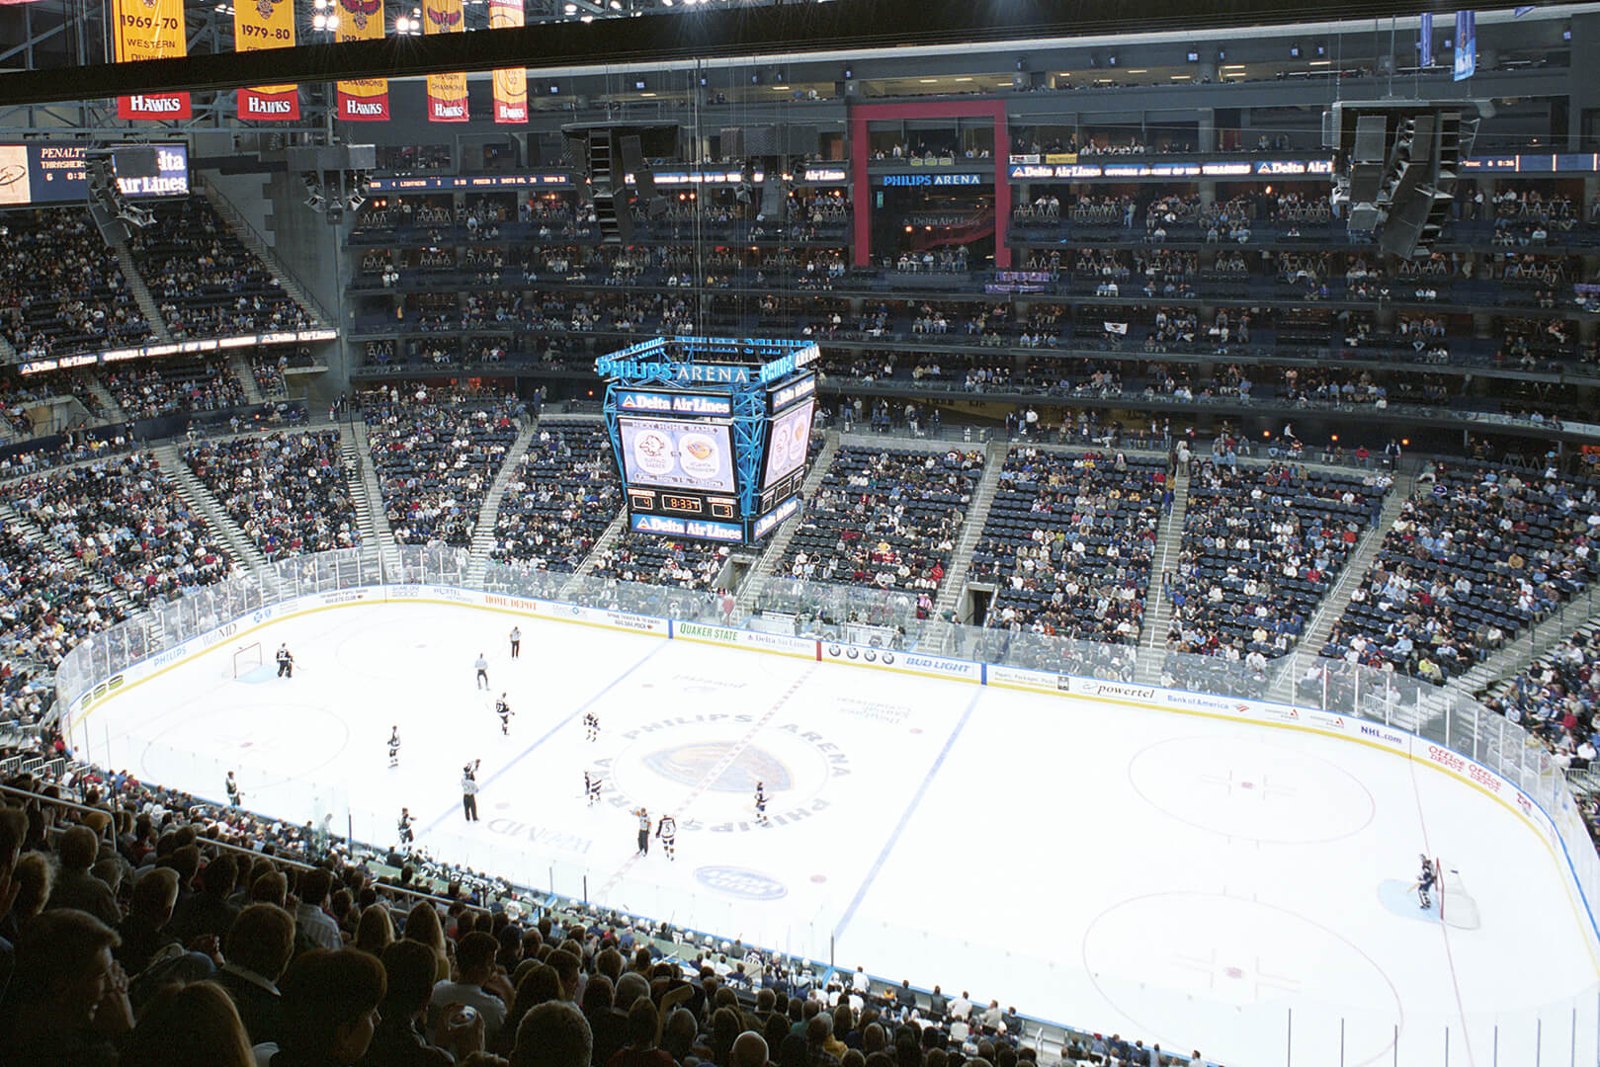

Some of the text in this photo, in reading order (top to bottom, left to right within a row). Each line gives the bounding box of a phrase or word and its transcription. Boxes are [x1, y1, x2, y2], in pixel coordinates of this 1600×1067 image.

[120, 14, 179, 30] 1969-70
[241, 24, 291, 40] 1979-80
[126, 38, 176, 49] WESTERN
[1025, 166, 1053, 177] Delta
[1272, 162, 1304, 173] Delta
[142, 175, 188, 193] Lines
[883, 174, 980, 187] PHILIPS ARENA
[597, 358, 748, 383] PHILIPS ARENA
[635, 394, 731, 413] Delta Air Lines
[650, 517, 742, 540] Delta Air Lines
[679, 622, 738, 641] QUAKER STATE
[153, 646, 187, 667] PHILIPS
[906, 656, 971, 673] BUD LIGHT
[1097, 683, 1155, 700] powertel
[1167, 694, 1187, 704] Bank
[1197, 698, 1230, 710] America
[1360, 725, 1403, 745] NHL.com
[621, 712, 852, 779] PHILIPS ARENA
